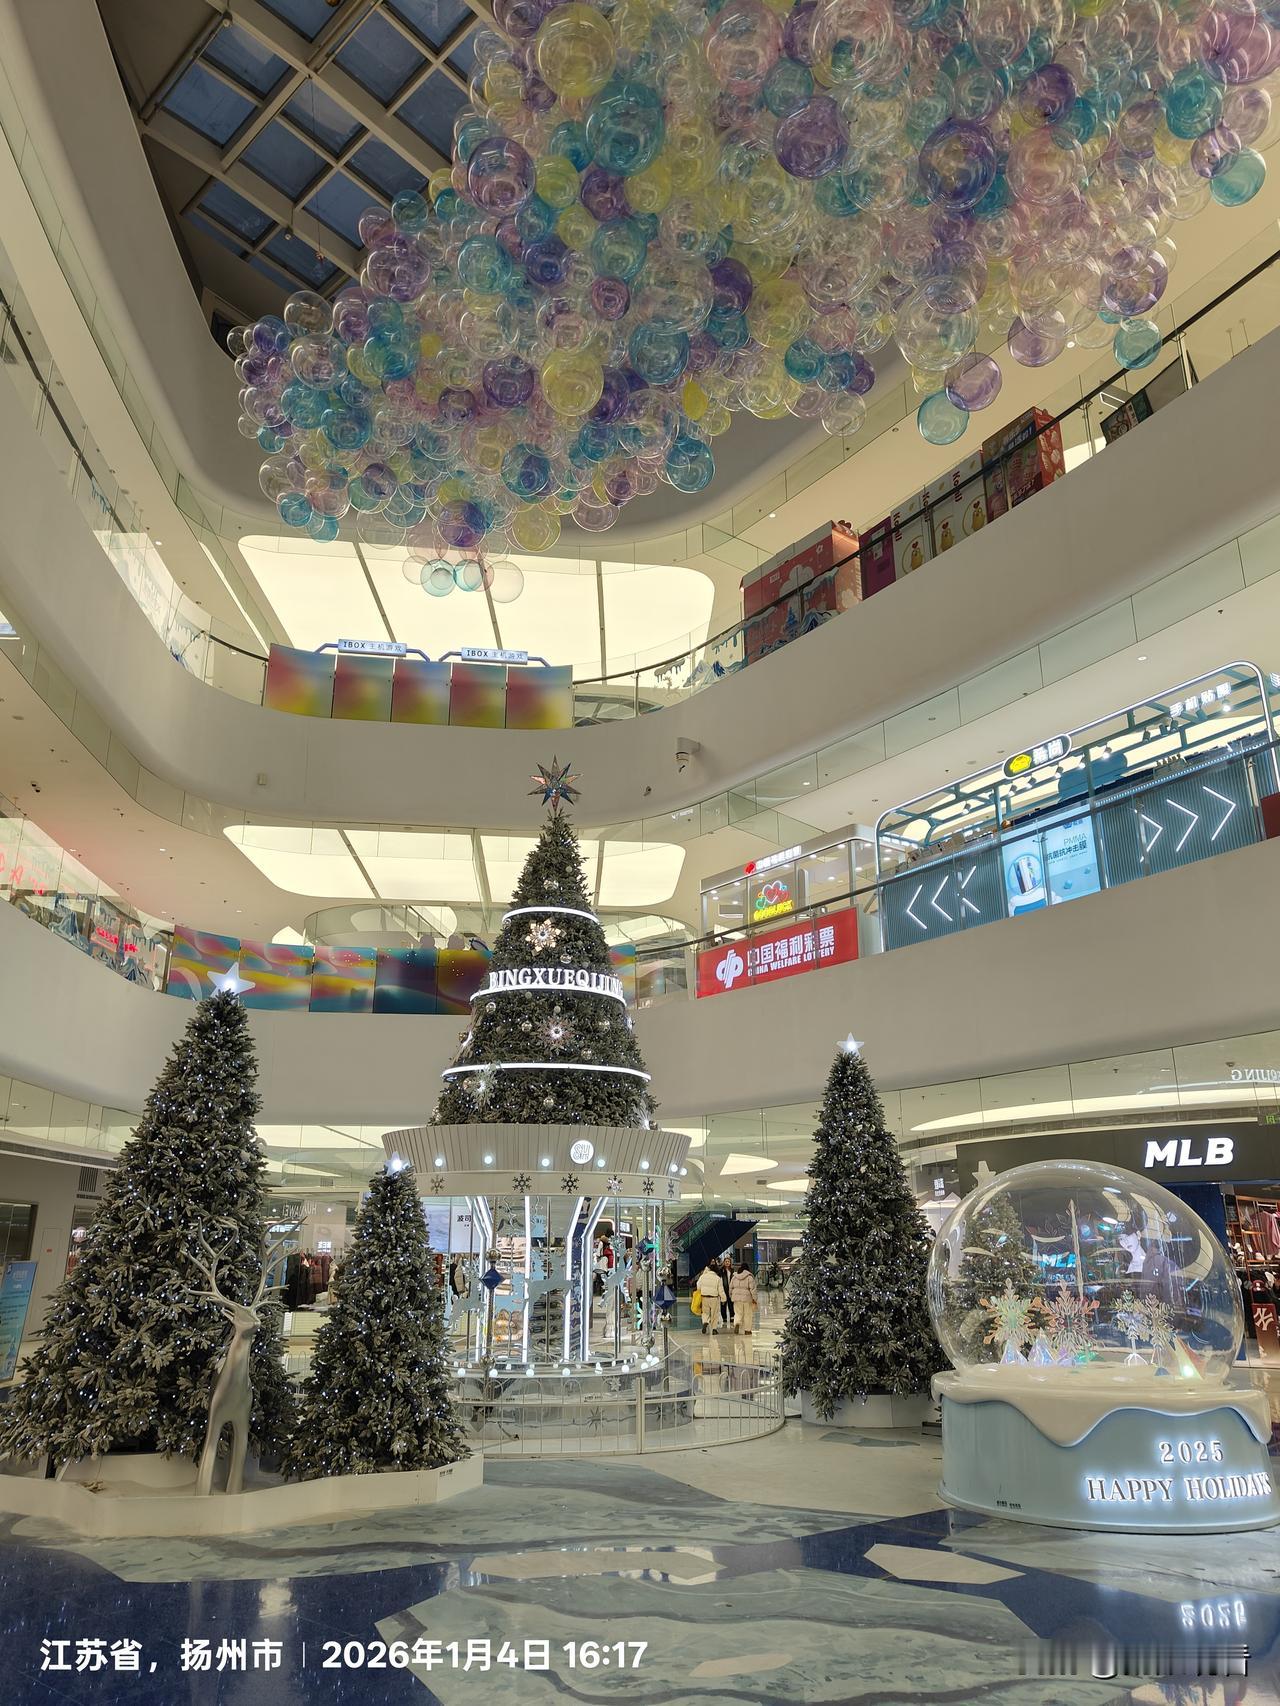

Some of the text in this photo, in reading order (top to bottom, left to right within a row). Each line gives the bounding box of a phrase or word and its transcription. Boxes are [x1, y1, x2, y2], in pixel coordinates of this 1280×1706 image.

[343, 641, 403, 652] IBOX 主机游戏
[466, 649, 524, 660] IBOX 主机游戏
[1169, 682, 1232, 718] 手机贴膜
[1063, 833, 1087, 846] PMMA
[770, 955, 802, 971] WELFARE
[1145, 1137, 1233, 1168] MLB
[1158, 1440, 1225, 1464] 2025
[1085, 1472, 1273, 1503] HAPPY HOLIDAYS
